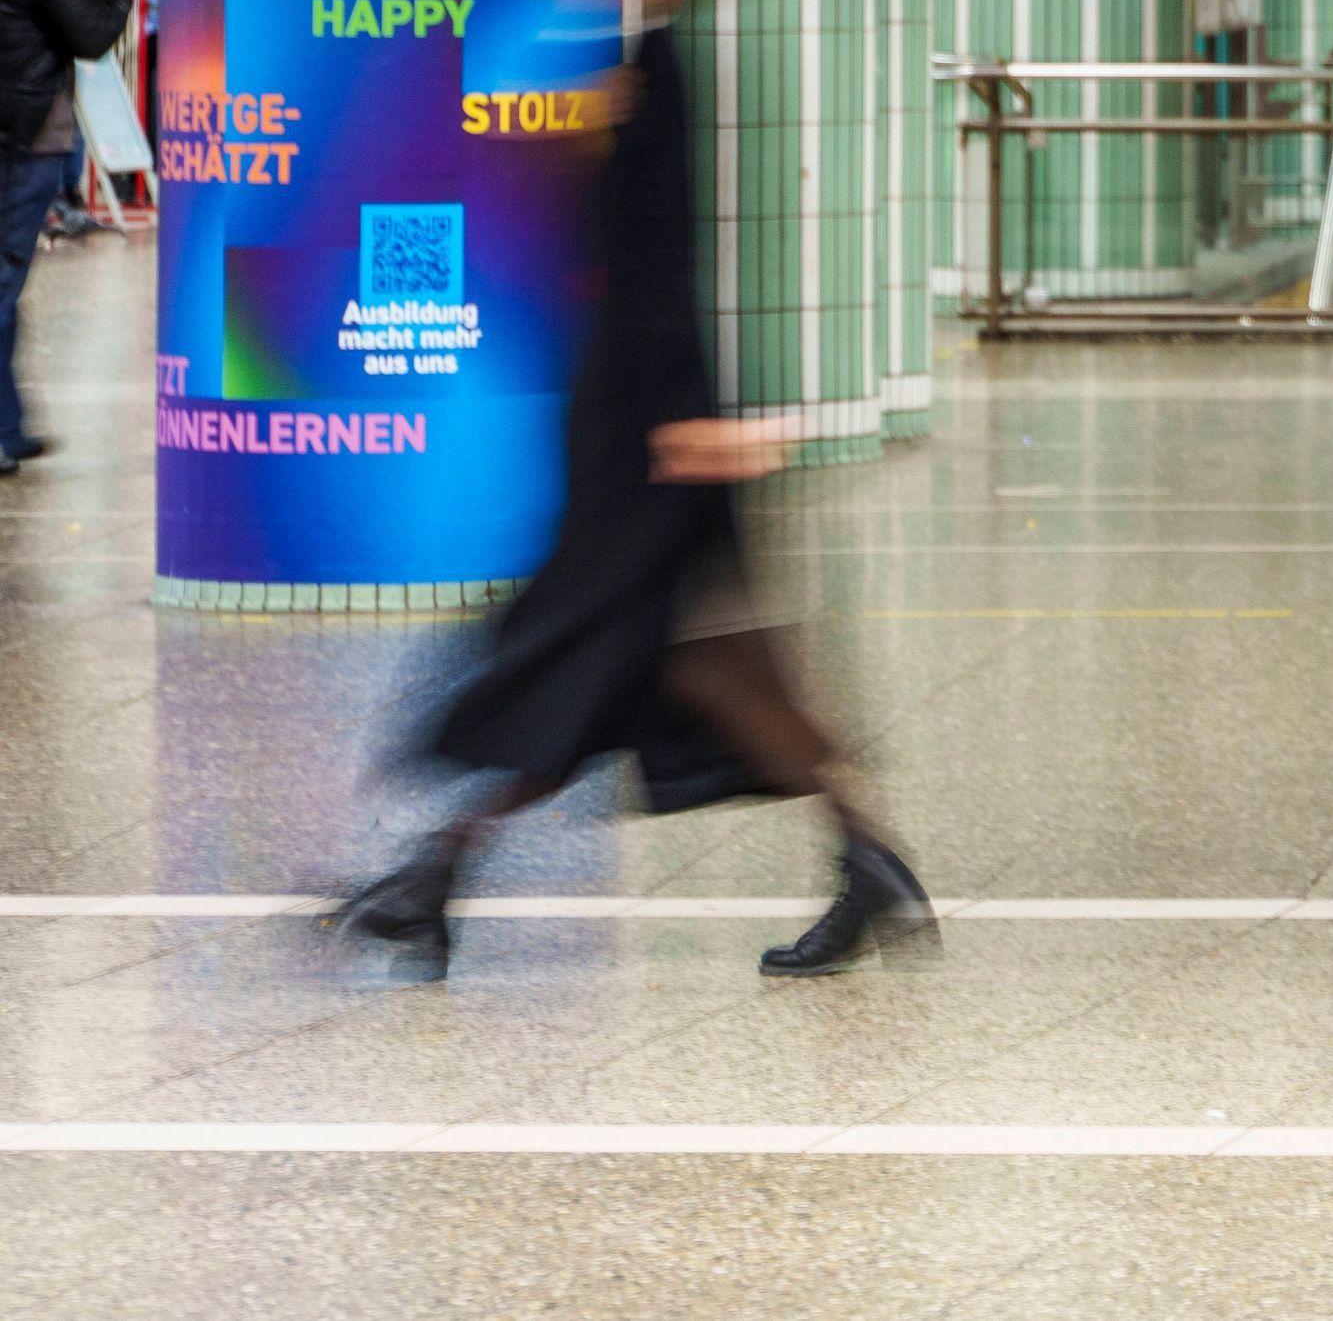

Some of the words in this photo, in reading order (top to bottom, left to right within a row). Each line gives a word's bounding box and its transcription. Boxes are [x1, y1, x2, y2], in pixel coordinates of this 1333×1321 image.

[160, 91, 301, 135] WERTGE-
[462, 91, 584, 135] STOLZ
[160, 133, 299, 185] SCHÄTZT
[342, 299, 479, 330] Ausbildung
[338, 325, 415, 350] macht
[420, 324, 483, 350] mehr
[363, 354, 409, 375] aus
[413, 354, 459, 374] uns
